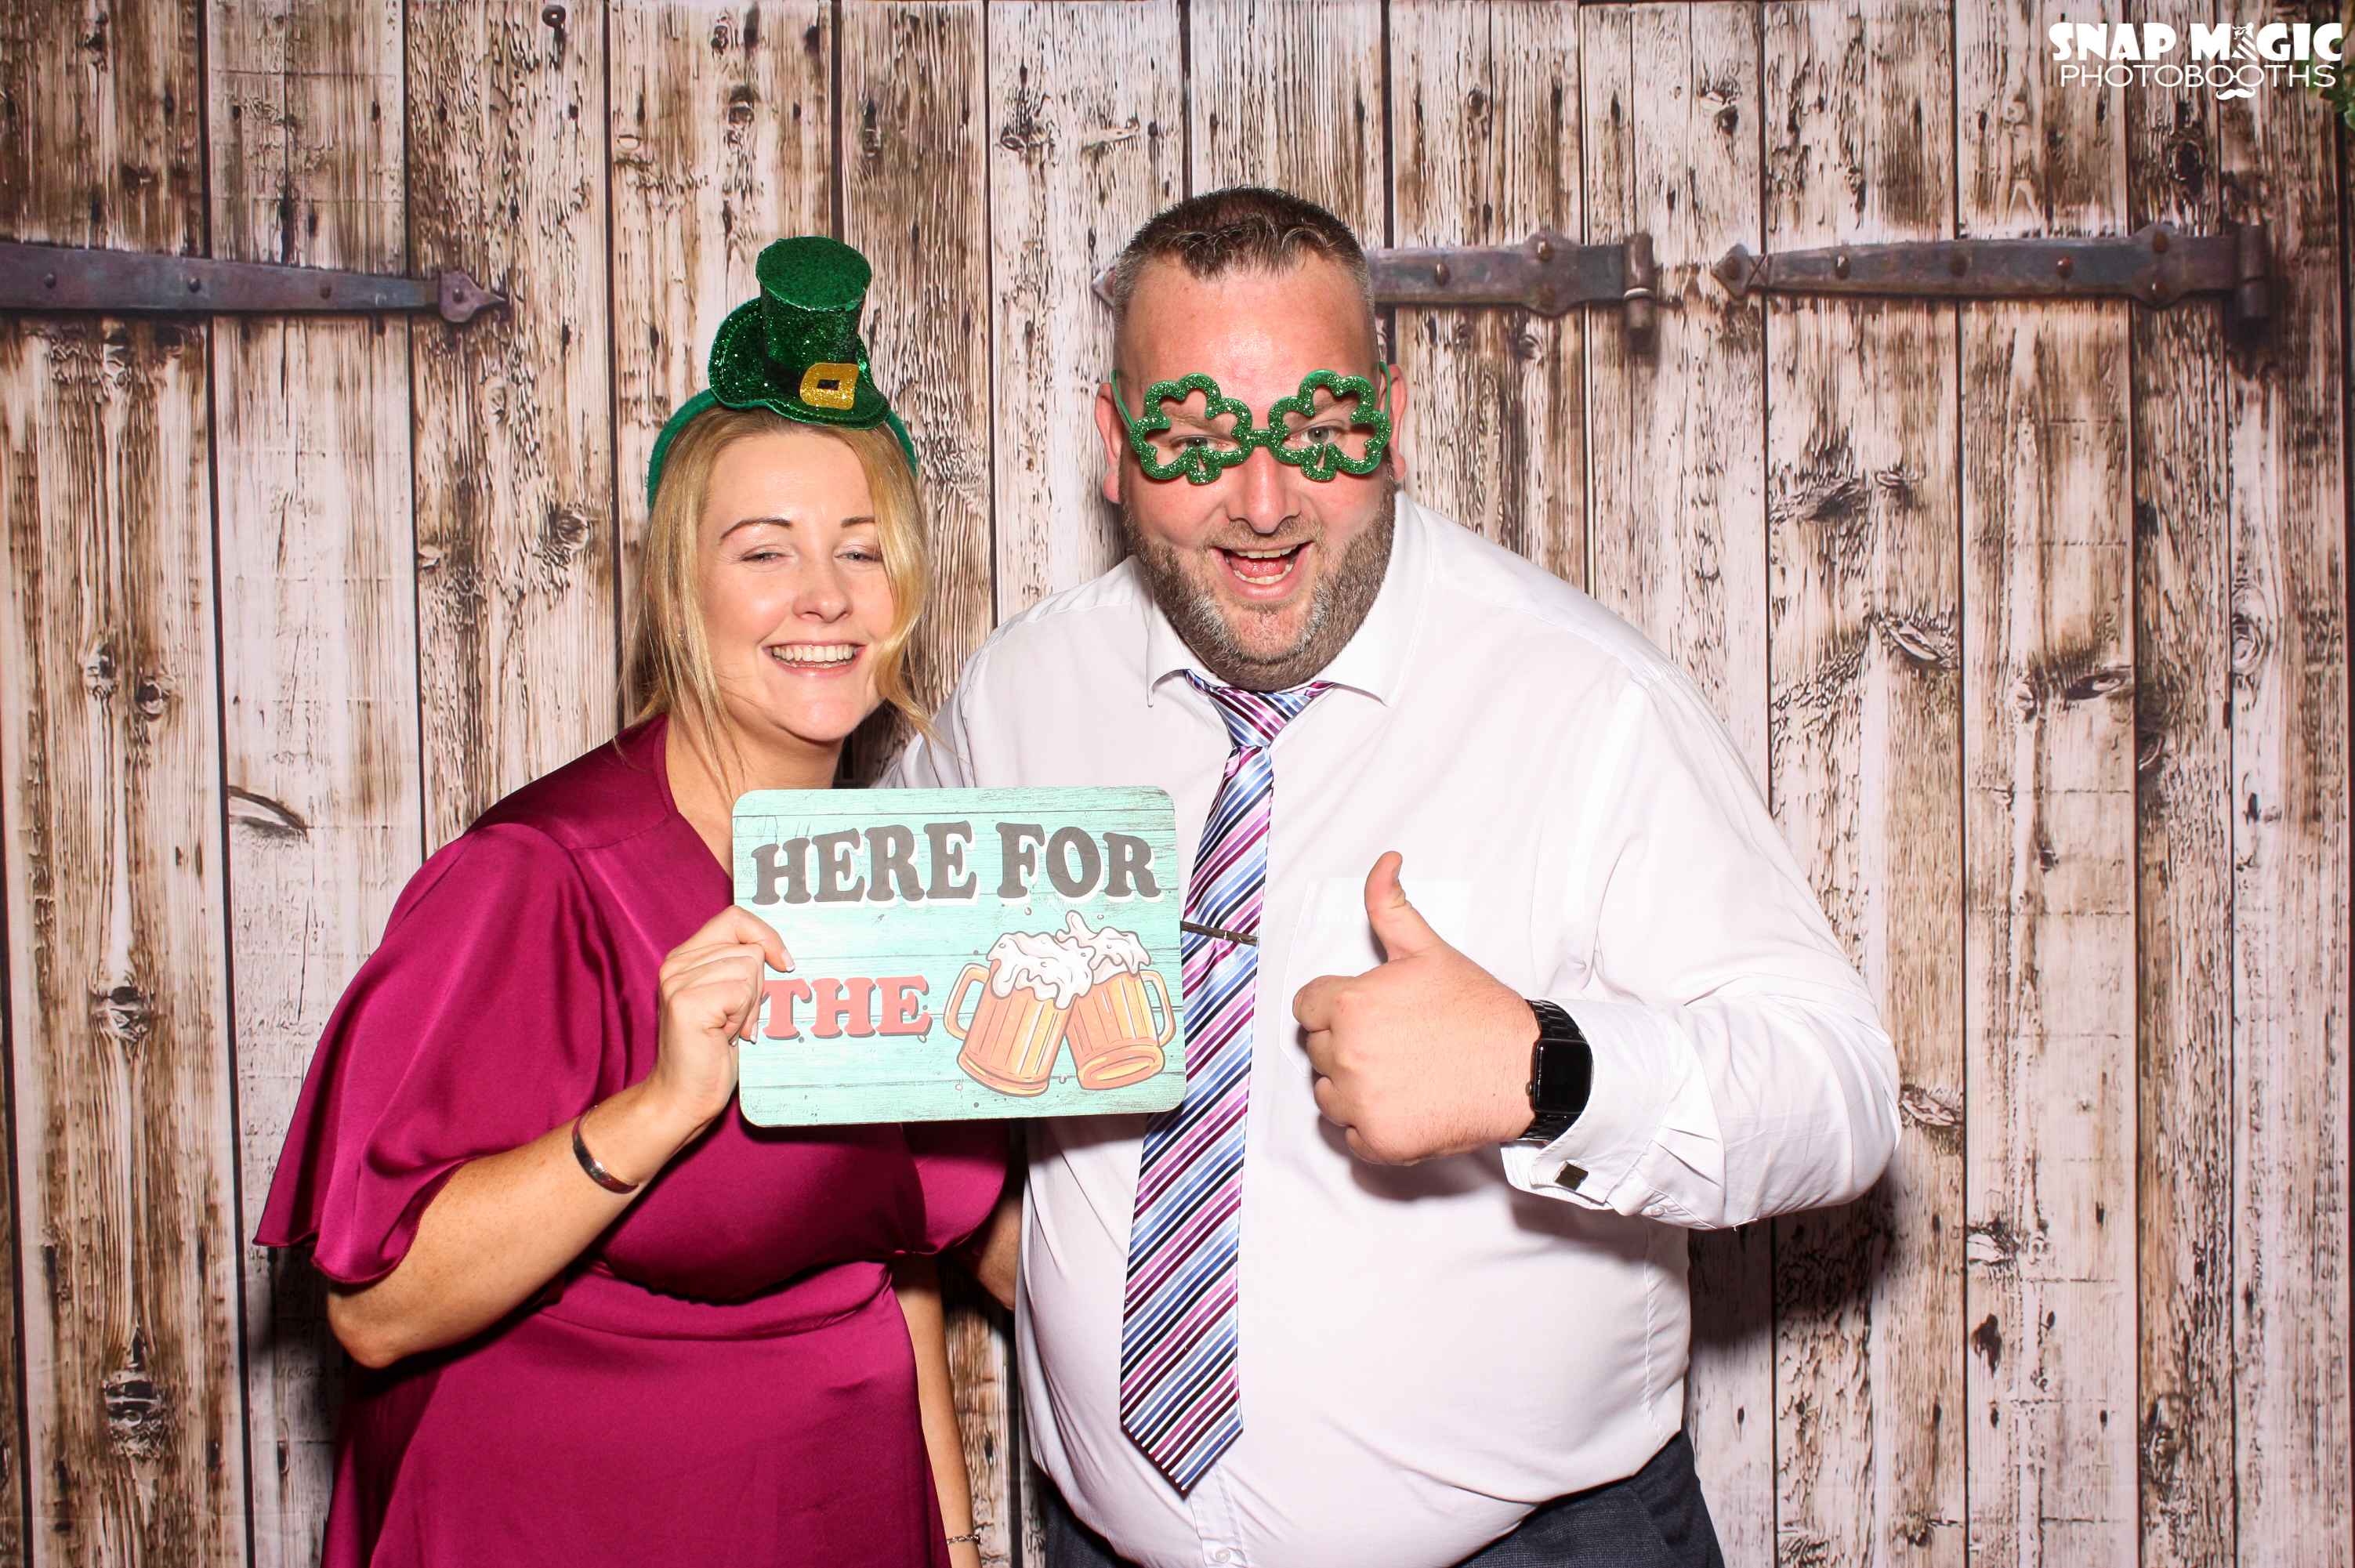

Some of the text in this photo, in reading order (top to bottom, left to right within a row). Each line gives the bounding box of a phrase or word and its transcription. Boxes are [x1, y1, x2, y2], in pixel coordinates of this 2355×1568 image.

[751, 820, 1165, 905] HERE FOR
[759, 974, 933, 1040] THE
